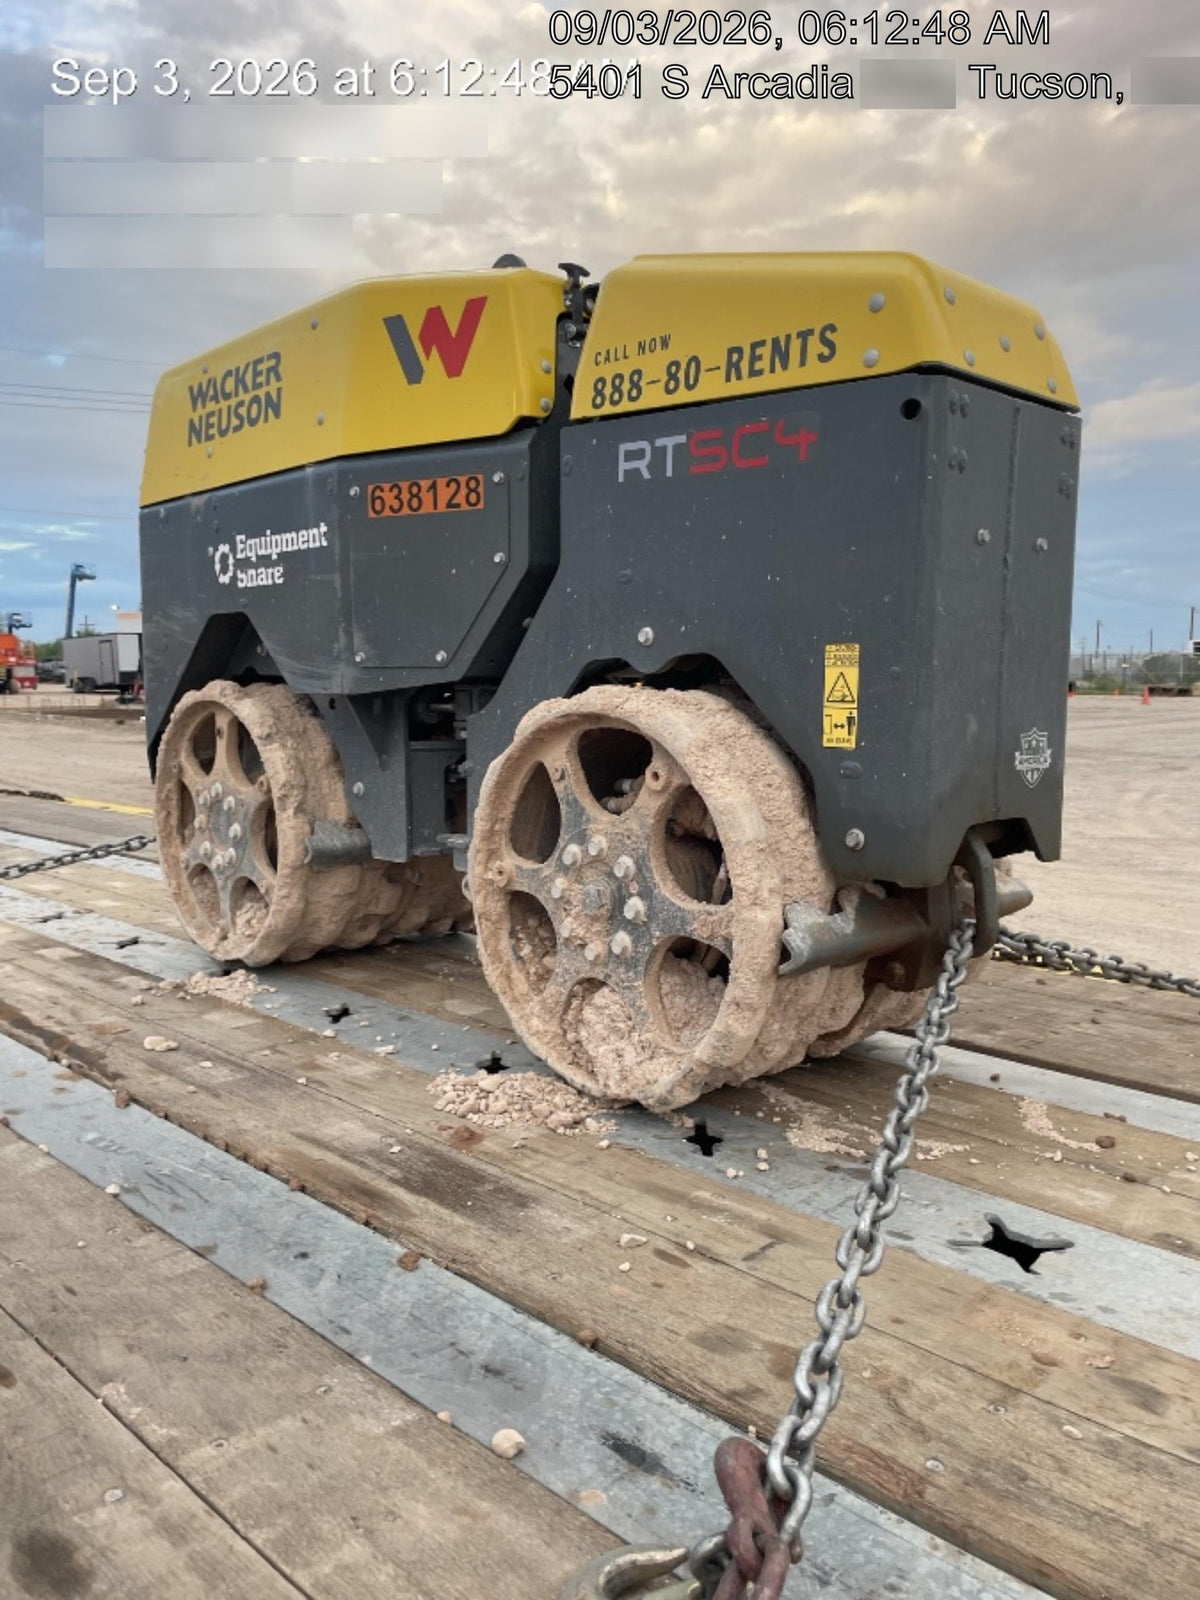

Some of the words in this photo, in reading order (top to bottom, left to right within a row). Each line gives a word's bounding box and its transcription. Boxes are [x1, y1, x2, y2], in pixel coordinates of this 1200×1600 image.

[591, 323, 838, 410] 888-80-RENTS
[594, 345, 630, 367] CALL
[637, 334, 672, 356] NOW
[188, 351, 283, 413] WACKER
[187, 387, 283, 448] NEUSON
[370, 476, 482, 516] 638128
[235, 522, 328, 563] Equipment
